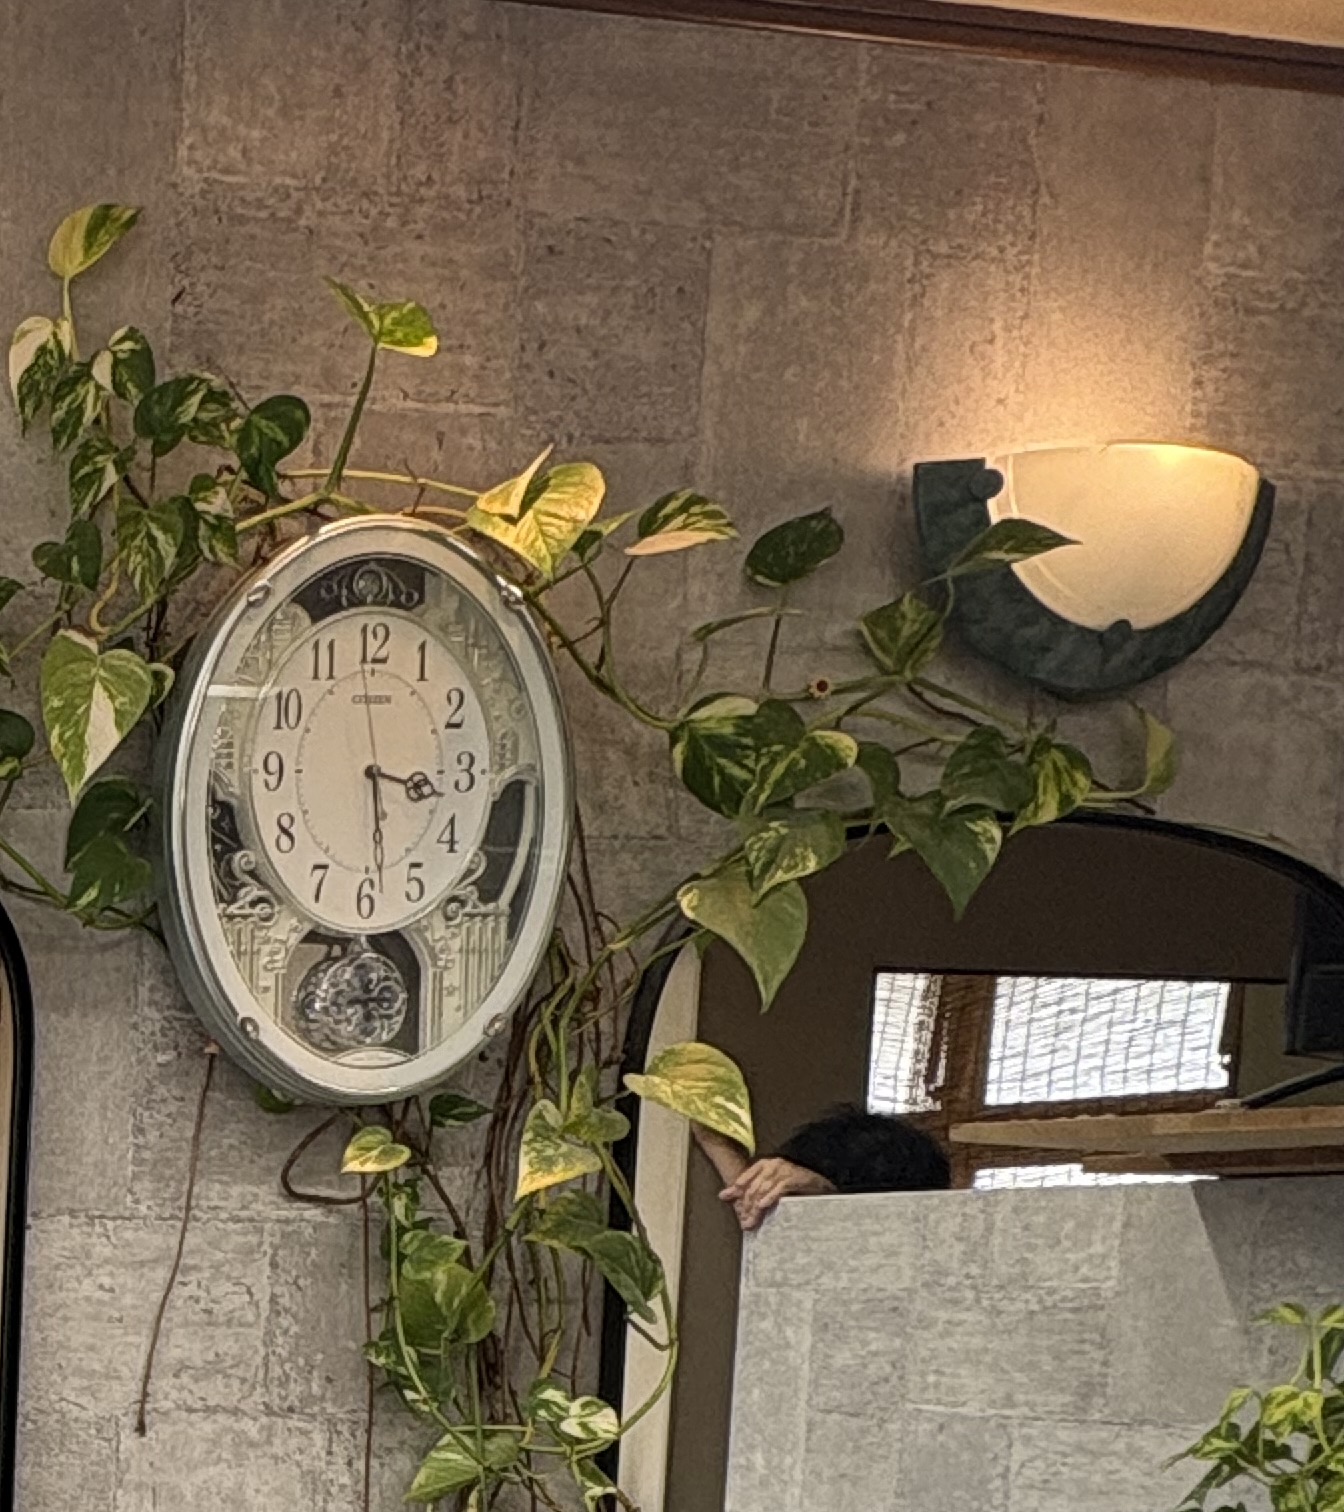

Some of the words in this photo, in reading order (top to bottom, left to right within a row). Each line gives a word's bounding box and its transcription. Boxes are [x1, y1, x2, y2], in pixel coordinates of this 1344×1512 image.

[311, 638, 336, 681] 11
[359, 622, 391, 665] 12
[415, 638, 430, 682] 1
[272, 688, 303, 730] 10
[444, 687, 466, 730] 2
[263, 750, 284, 792] 9
[453, 751, 476, 793] 3
[275, 812, 296, 854] 8
[436, 812, 460, 854] 4
[310, 863, 330, 903] 7
[356, 877, 376, 920] 6
[404, 862, 426, 902] 5
